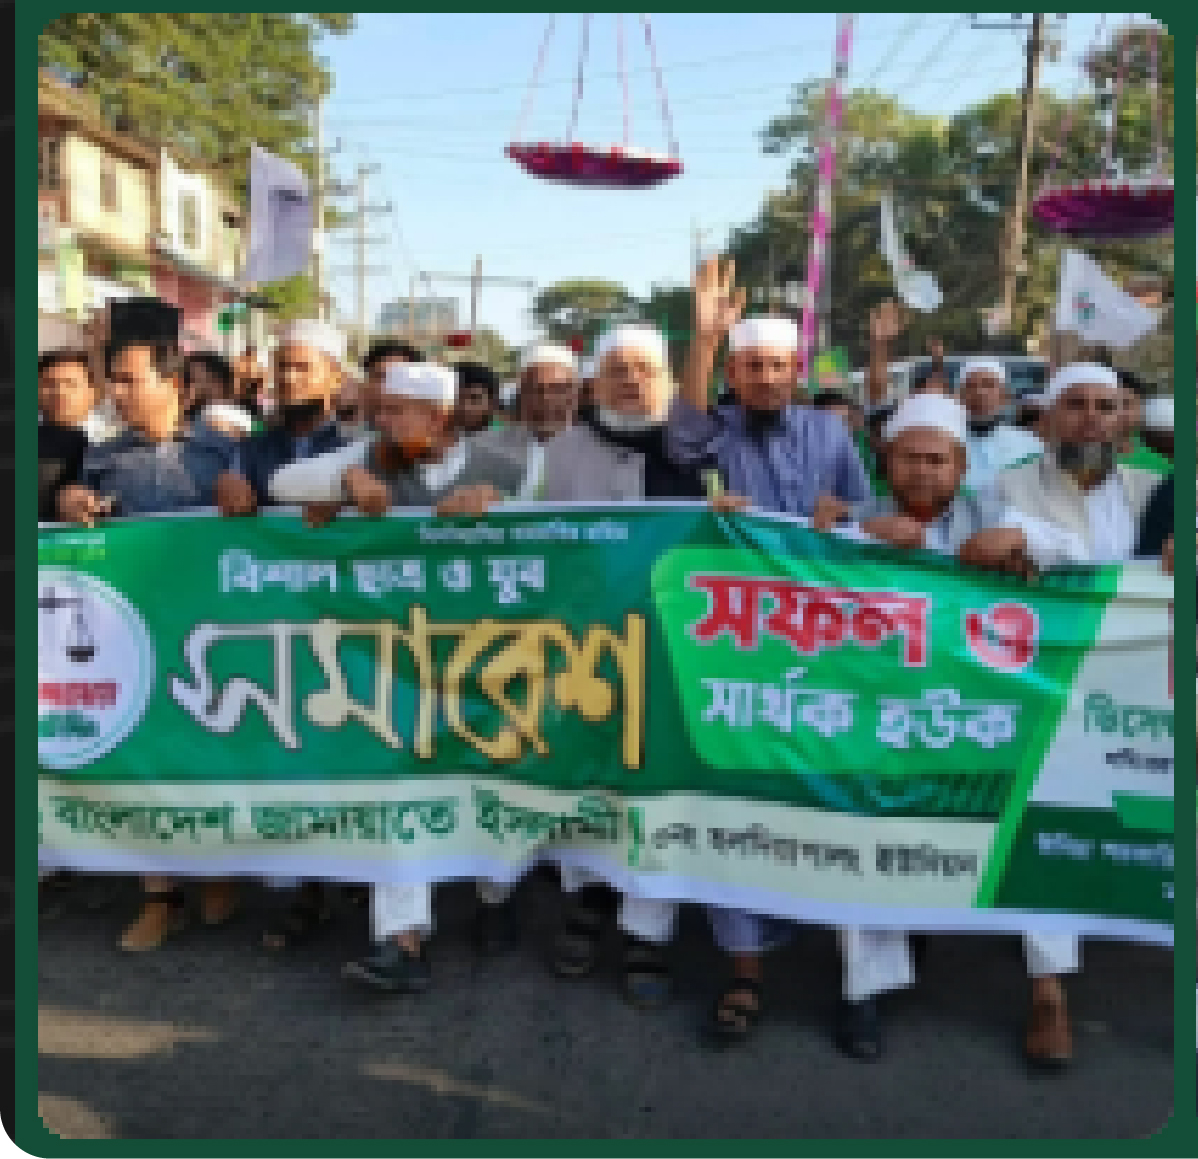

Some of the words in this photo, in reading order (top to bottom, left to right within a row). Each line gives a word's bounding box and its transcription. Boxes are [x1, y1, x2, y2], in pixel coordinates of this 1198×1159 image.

[217, 546, 338, 594] বিশাল
[438, 556, 472, 593] ও
[684, 572, 932, 668] সফল
[964, 598, 1040, 673] ও
[169, 603, 650, 770] সমাবেশ
[700, 666, 859, 738] সার্থক
[875, 688, 1023, 749] হউক
[50, 794, 236, 843] বাংলাদেশ
[250, 797, 458, 844] জামায়াতে
